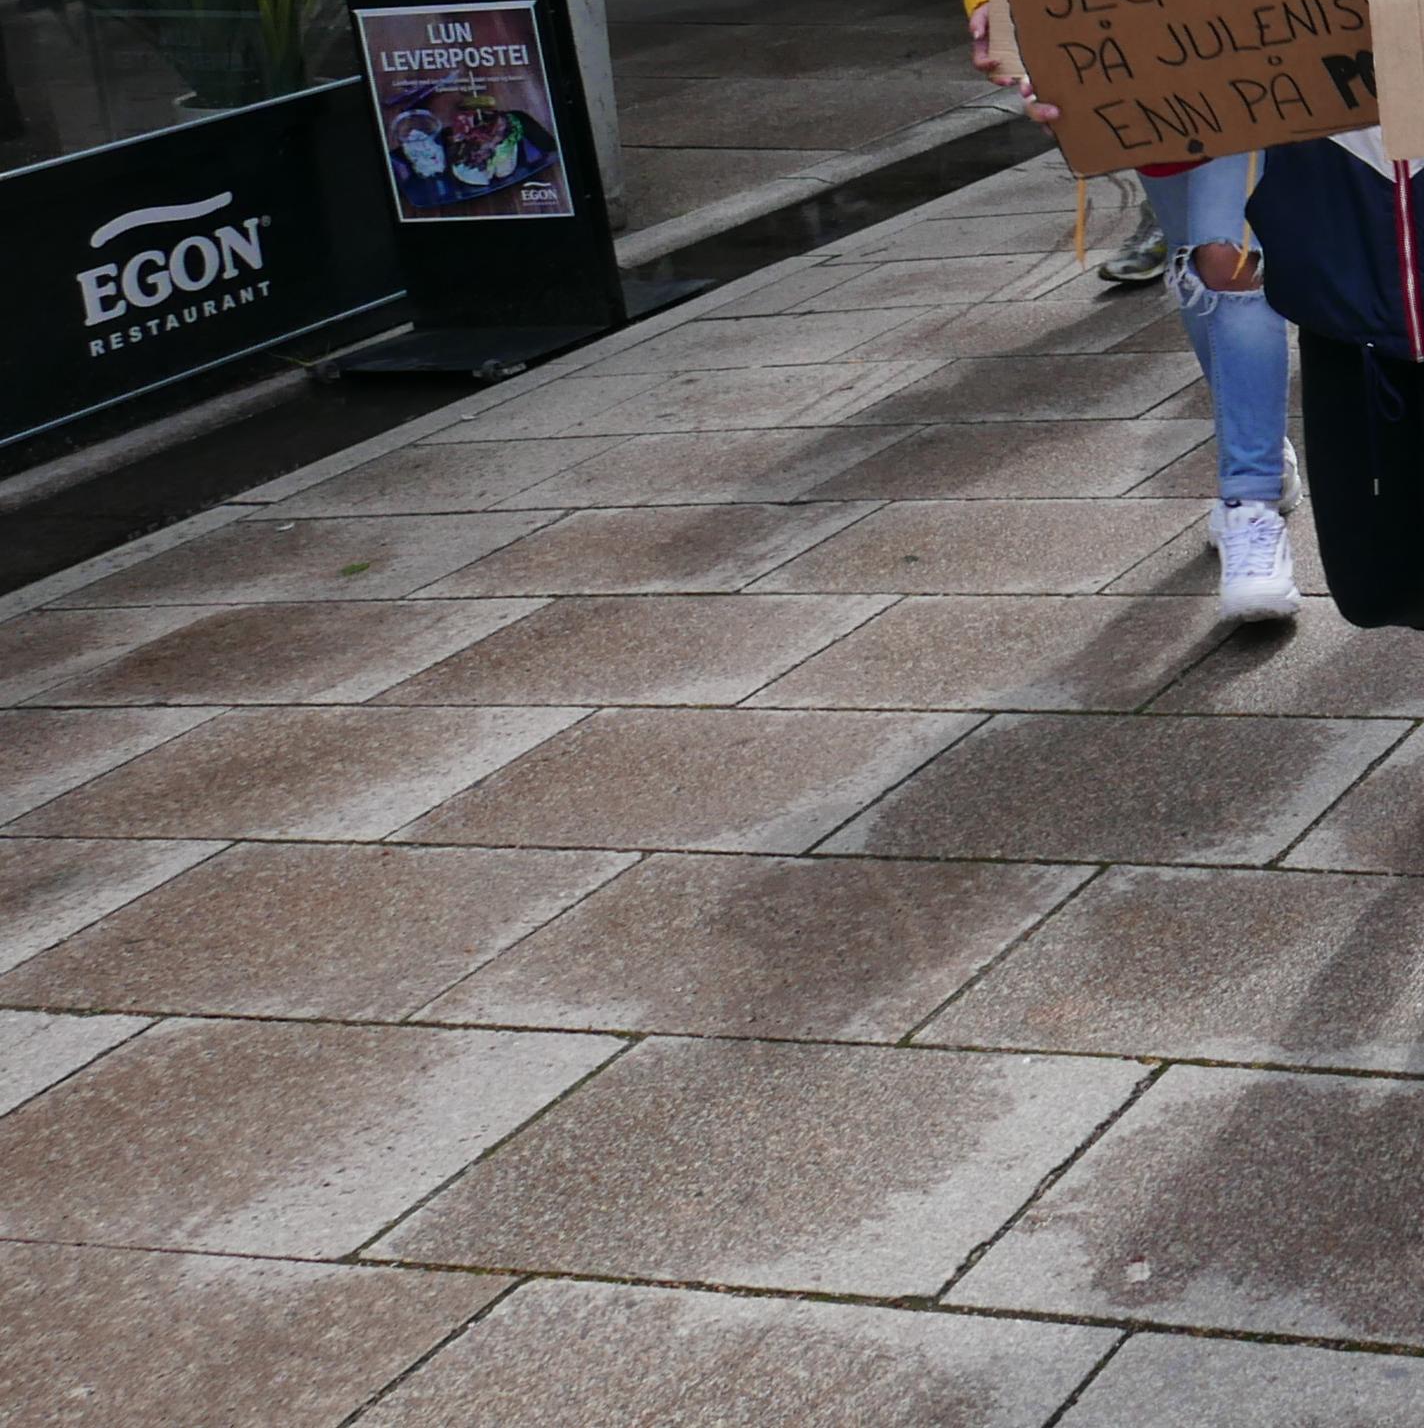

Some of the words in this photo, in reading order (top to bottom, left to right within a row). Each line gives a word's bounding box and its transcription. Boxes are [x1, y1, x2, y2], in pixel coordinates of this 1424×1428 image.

[380, 44, 530, 73] LEVERPOSTEI
[427, 22, 473, 45] LUN
[1058, 18, 1134, 85] PÅ
[1093, 92, 1223, 150] ENN
[1228, 55, 1314, 124] PÅ
[521, 189, 558, 202] EGON
[76, 217, 264, 327] EGON
[89, 280, 270, 357] RESTAURANT
